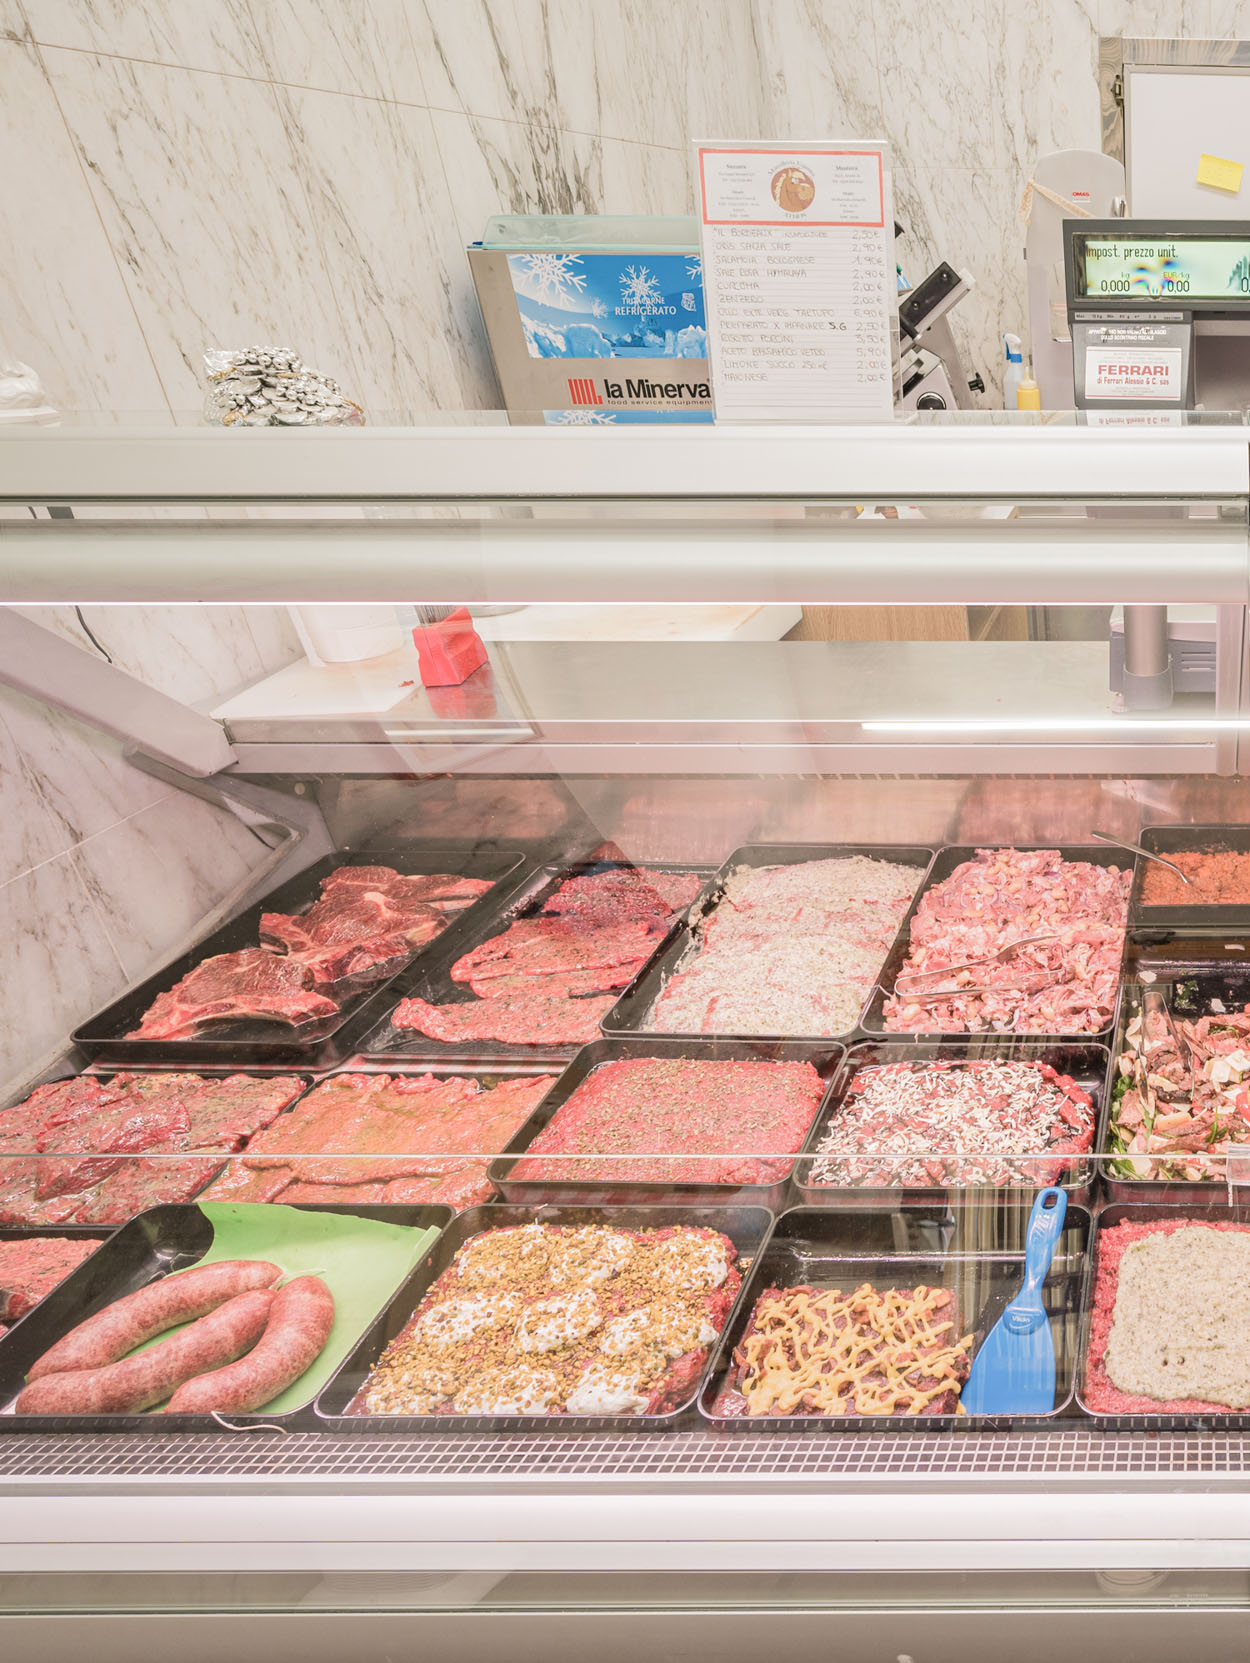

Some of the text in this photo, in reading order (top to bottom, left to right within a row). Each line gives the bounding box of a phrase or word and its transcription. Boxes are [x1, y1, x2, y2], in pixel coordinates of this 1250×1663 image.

[1124, 246, 1154, 260] prezzo
[1157, 245, 1179, 258] unit.
[1101, 280, 1130, 294] 0,000
[1167, 280, 1190, 294] 0,00
[615, 306, 677, 316] REFRIGERATO
[1098, 364, 1169, 376] FERRARI
[1097, 376, 1102, 384] di
[1104, 376, 1123, 385] Ferrari
[1125, 377, 1144, 385] Alessio
[1146, 377, 1150, 385] &
[604, 378, 711, 399] la Minerva
